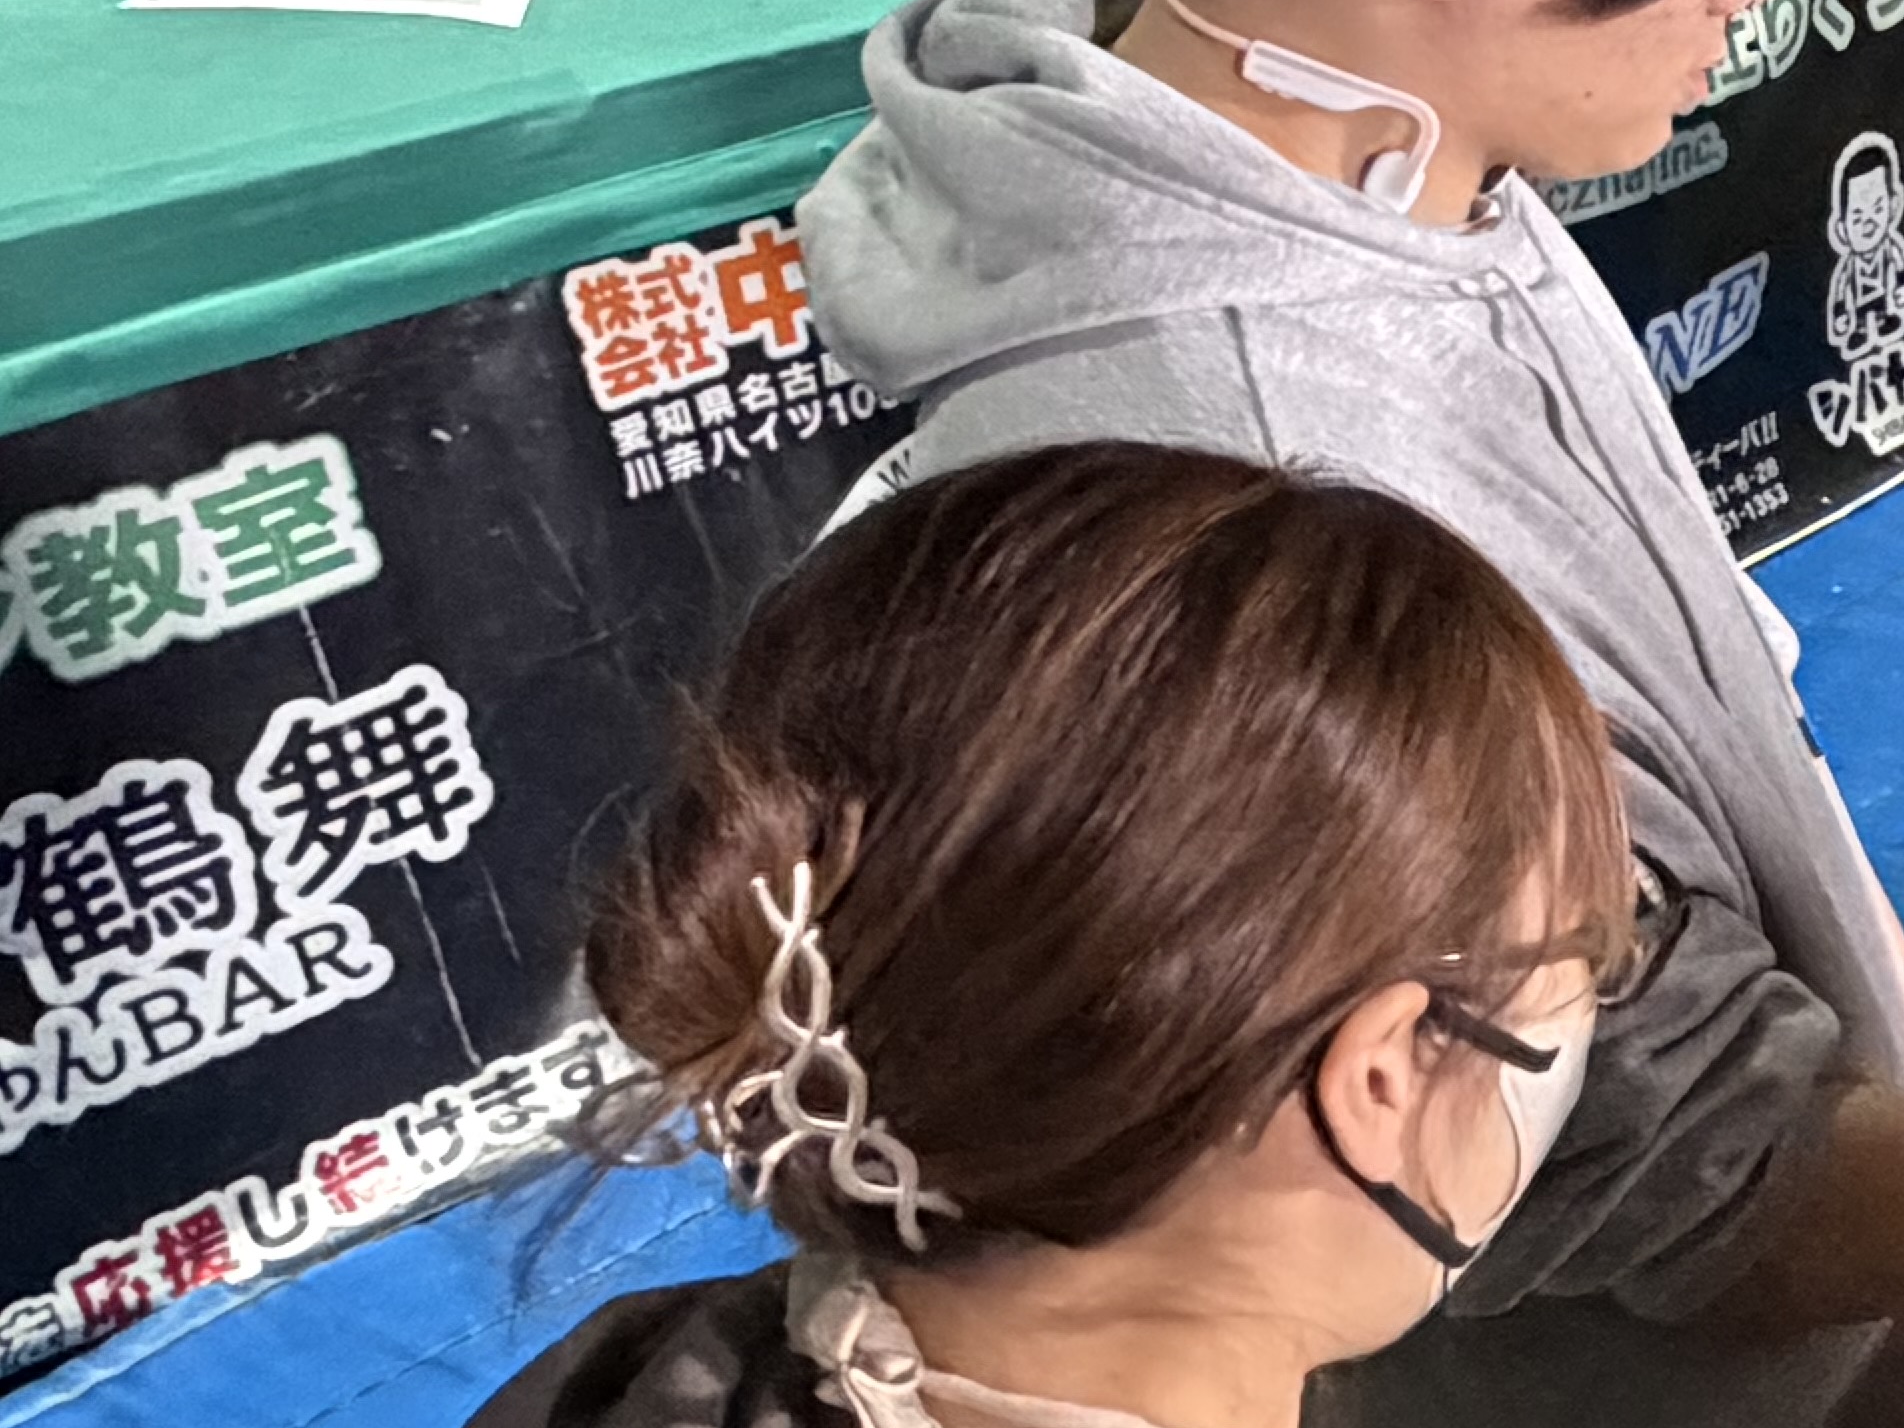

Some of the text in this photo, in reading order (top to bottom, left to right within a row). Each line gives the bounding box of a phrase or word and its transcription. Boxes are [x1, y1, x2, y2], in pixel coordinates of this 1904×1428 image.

[622, 385, 900, 500] 川奈ハイツ10
[0, 454, 358, 664] 教室
